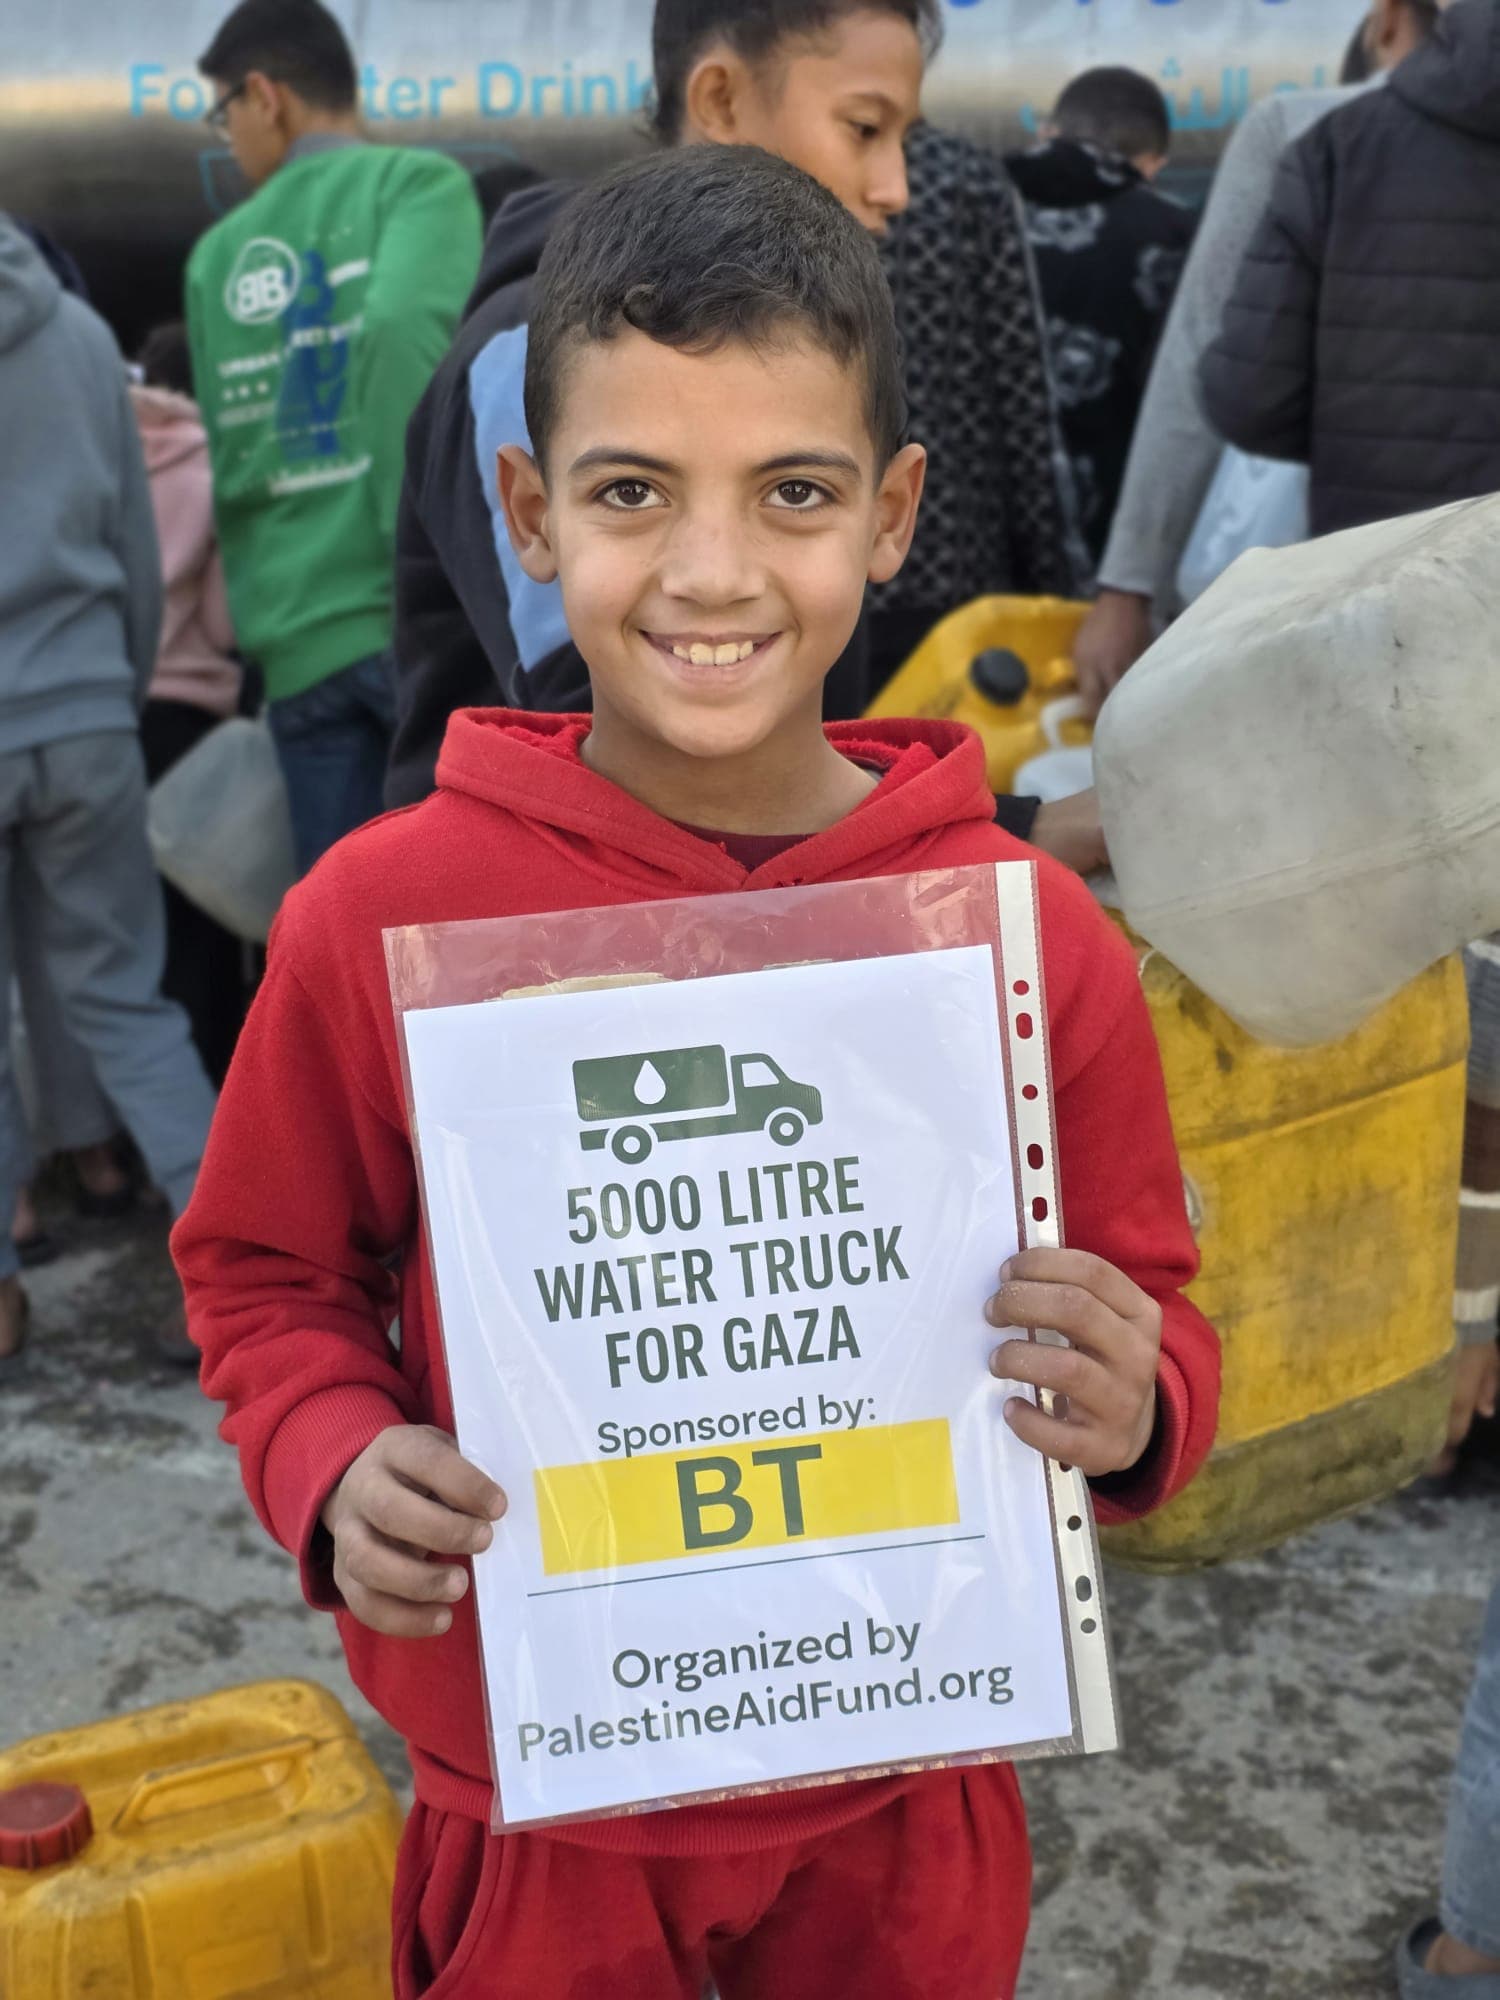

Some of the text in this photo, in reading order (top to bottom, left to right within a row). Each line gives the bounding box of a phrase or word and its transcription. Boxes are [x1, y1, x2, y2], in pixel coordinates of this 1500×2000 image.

[566, 1155, 866, 1245] 5000 LITRE
[533, 1224, 910, 1323] WATER TRUCK
[605, 1304, 862, 1389] FOR GAZA
[596, 1393, 877, 1457] Sponsored by:
[675, 1442, 824, 1551] BT
[611, 1617, 922, 1693] Organized by
[516, 1664, 1015, 1763] PalestineAidFund.org
